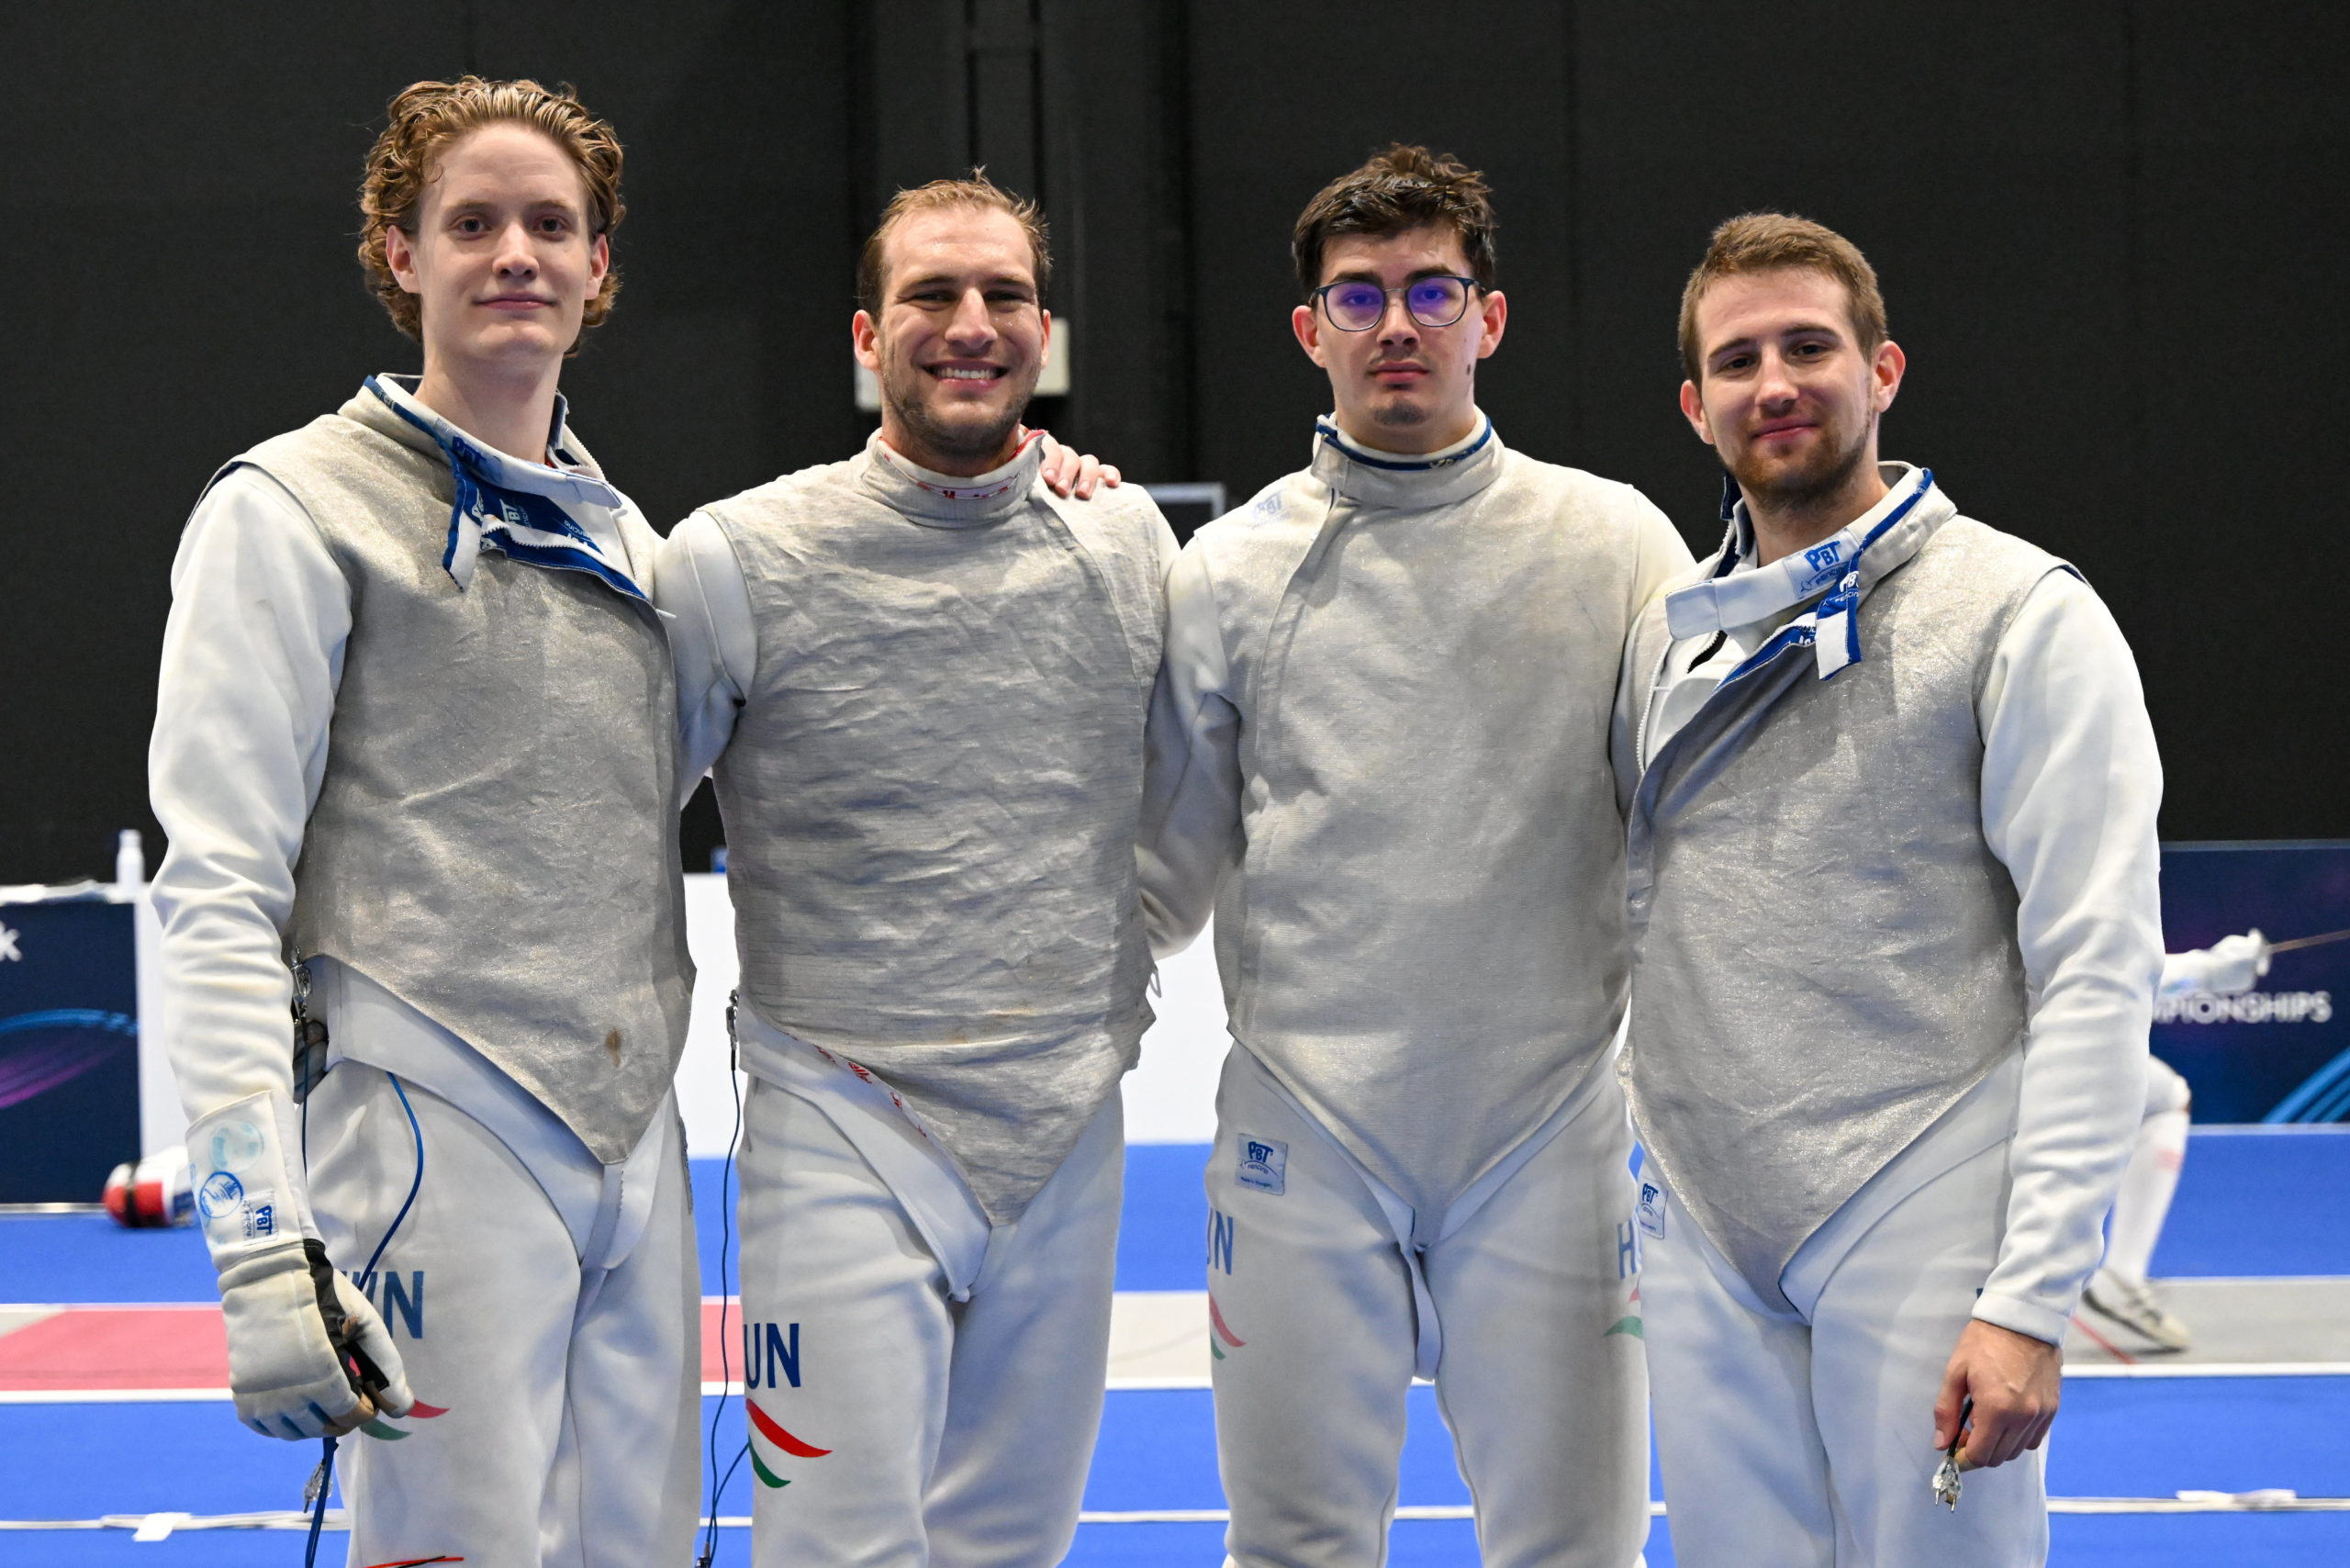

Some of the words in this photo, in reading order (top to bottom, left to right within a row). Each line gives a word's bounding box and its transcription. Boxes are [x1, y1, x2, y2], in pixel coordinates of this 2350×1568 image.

[1805, 541, 1841, 572] PBT
[1248, 1141, 1273, 1163] PBT
[1642, 1182, 1659, 1204] PBT
[256, 1204, 273, 1236] PBT
